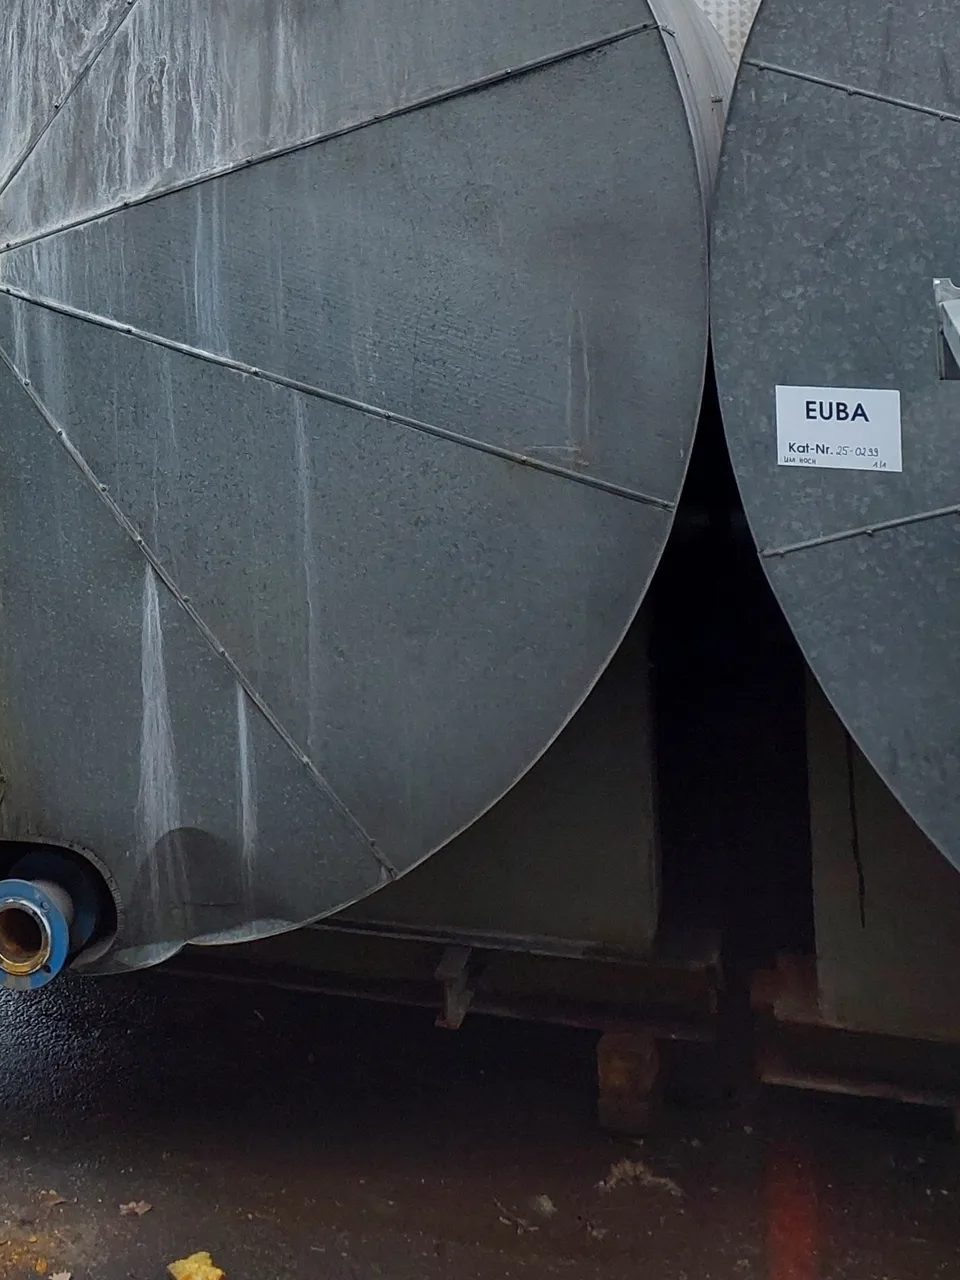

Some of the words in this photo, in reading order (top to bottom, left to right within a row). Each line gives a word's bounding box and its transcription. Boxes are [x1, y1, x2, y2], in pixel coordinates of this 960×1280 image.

[805, 400, 870, 422] EUBA
[788, 442, 834, 455] Kat-Nr.
[836, 445, 879, 457] 25-0299
